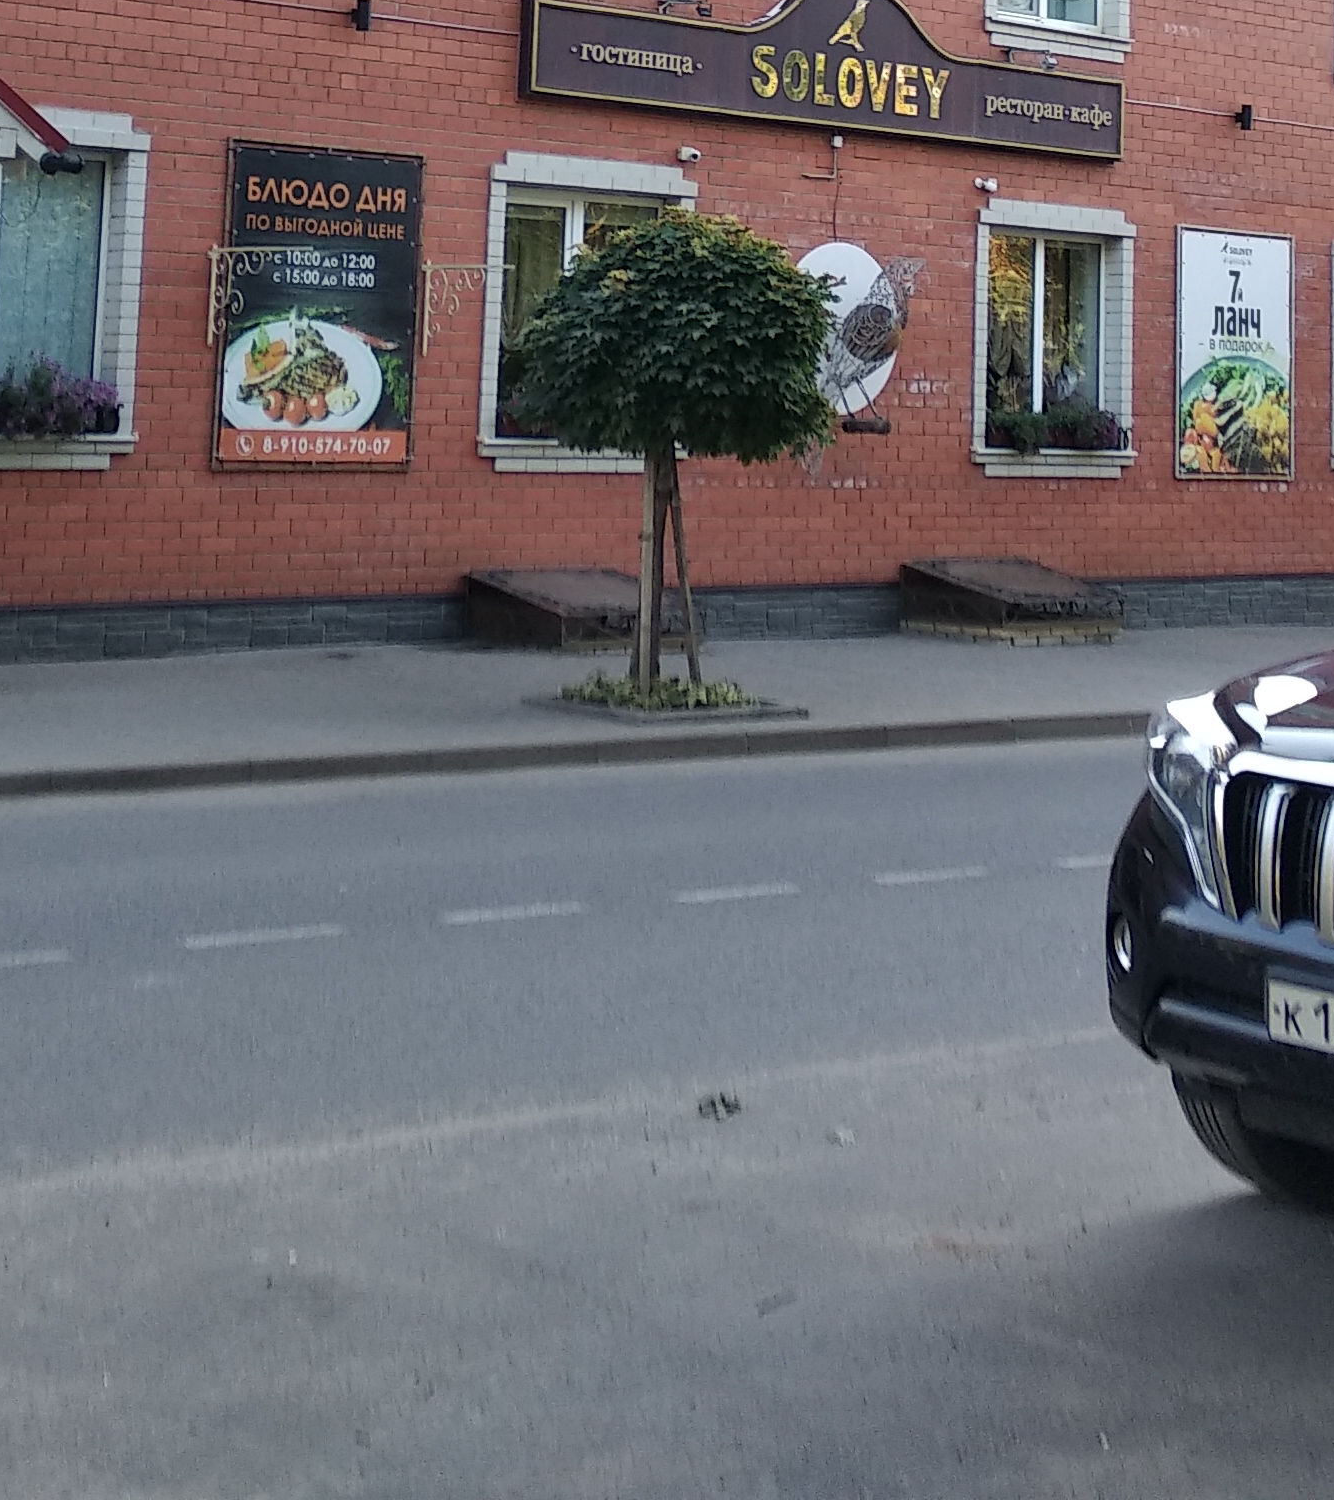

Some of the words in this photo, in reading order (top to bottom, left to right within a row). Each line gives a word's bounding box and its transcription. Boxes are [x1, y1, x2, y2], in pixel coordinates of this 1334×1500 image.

[750, 45, 951, 119] SOLOVEY
[246, 176, 350, 211] БЛЮДО
[355, 186, 408, 214] ДНЯ
[245, 214, 270, 231] ПО
[274, 216, 363, 237] ВЫГОДНОЙ
[367, 223, 405, 240] ЦЕНЕ
[286, 251, 321, 267] 10:00
[322, 256, 339, 268] до
[342, 253, 376, 270] 12:00
[285, 268, 320, 285] 15:00
[321, 274, 338, 287] до
[341, 272, 375, 288] 18:00
[1218, 339, 1264, 355] подарок
